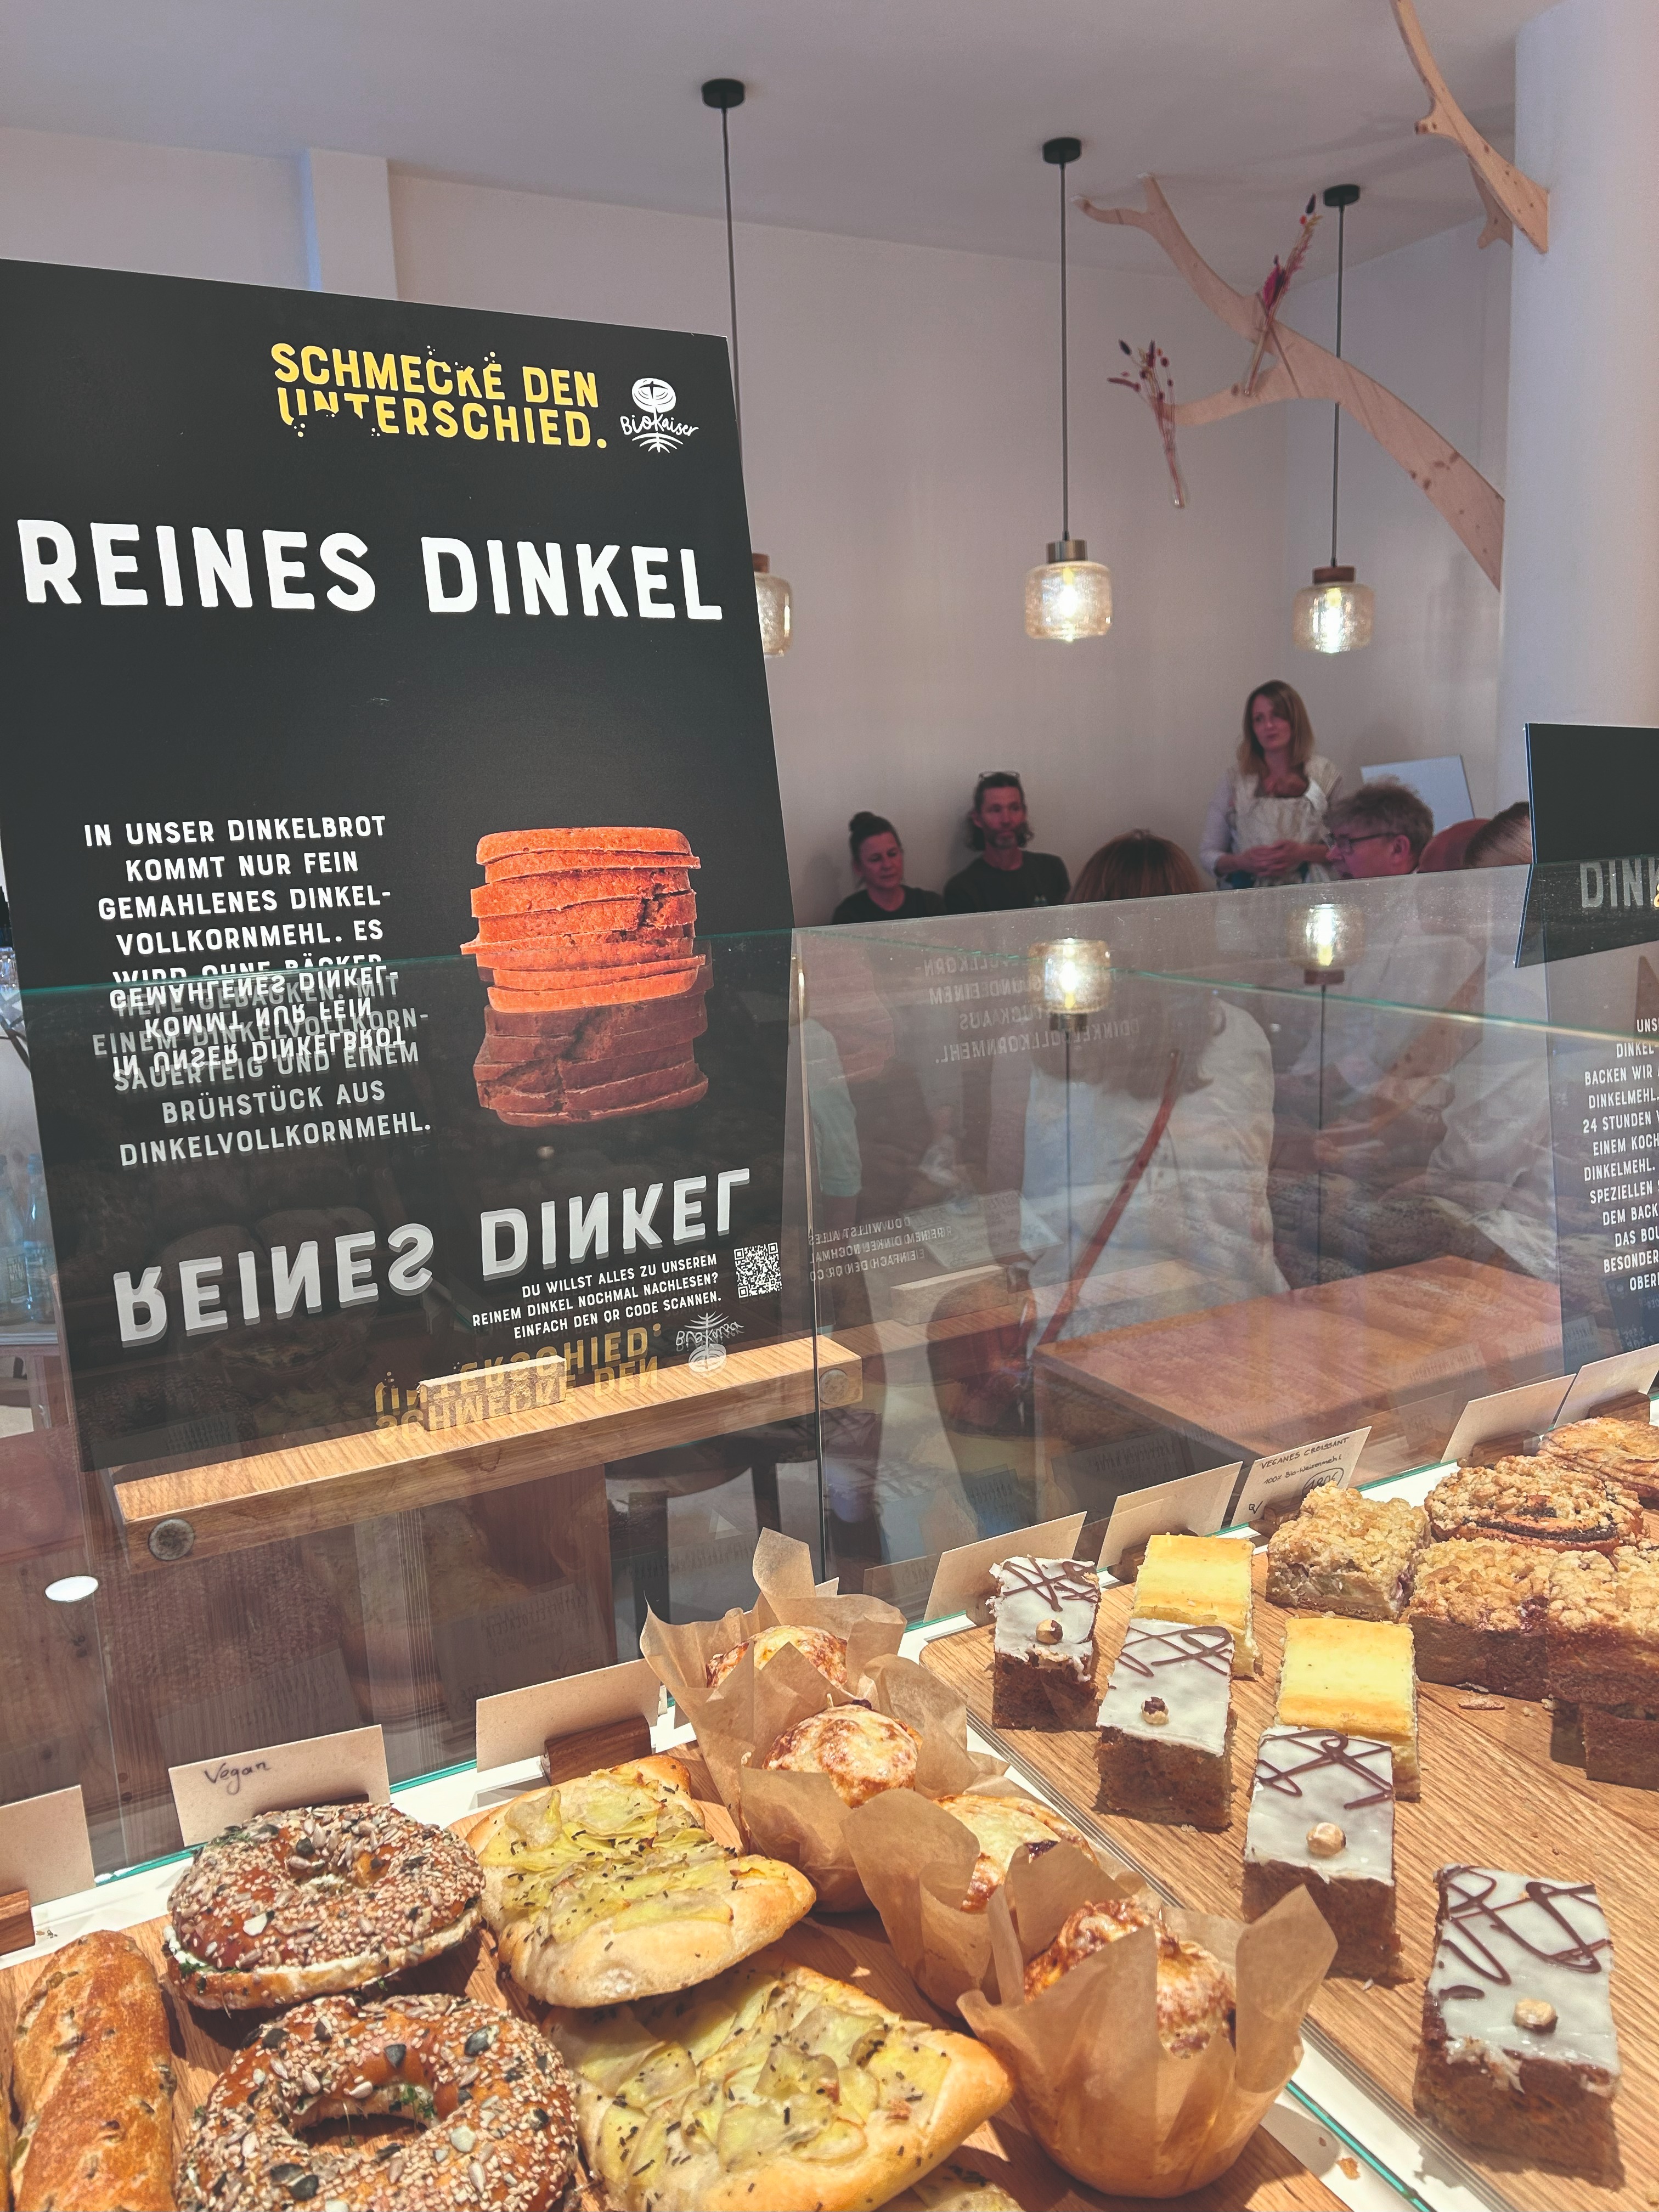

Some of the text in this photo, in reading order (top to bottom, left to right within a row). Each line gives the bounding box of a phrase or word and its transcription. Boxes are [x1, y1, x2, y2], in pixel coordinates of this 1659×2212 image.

[270, 343, 599, 408] SCHMECKE DEN
[276, 387, 607, 449] UNTERSCHIED.
[17, 519, 723, 620] REINES DINKEL
[84, 815, 386, 847] IN UNSER DINKELBROT
[125, 851, 358, 882] KOMMT NUR FEIN
[98, 884, 391, 920] GEMAHLENES DINKEL-
[116, 919, 383, 956] VOLLKORNMEHL. ES
[1637, 1017, 1659, 1032] UNS
[1584, 1066, 1627, 1086] BACKEN
[1632, 1064, 1652, 1080] WIR
[162, 1080, 386, 1124] BRÜHSTÜCK AUS
[1588, 1087, 1659, 1109] DINKELMEHL.
[120, 1111, 432, 1167] DINKELVOLLKORNMEHL.
[1583, 1118, 1598, 1134] 24
[1602, 1111, 1651, 1131] STUNDEN
[1593, 1137, 1626, 1156] EINEM
[1584, 1158, 1655, 1182] DINKELMEHL.
[1590, 1180, 1653, 1204] SPEZIELLEN
[1602, 1209, 1626, 1226] DEM
[1615, 1230, 1636, 1247] DAS
[522, 1254, 717, 1299] DU WILLST ALLES ZU UNSEREM
[1630, 1272, 1659, 1291] OBER
[472, 1272, 719, 1327] REINEM DINKEL NOCHMAL NACHLESEN?
[514, 1290, 722, 1339] EINFACH DEN QR CODE SCANNEN.
[1261, 1436, 1350, 1470] VEGANES CROISSANT
[204, 1760, 273, 1796] Vegan
